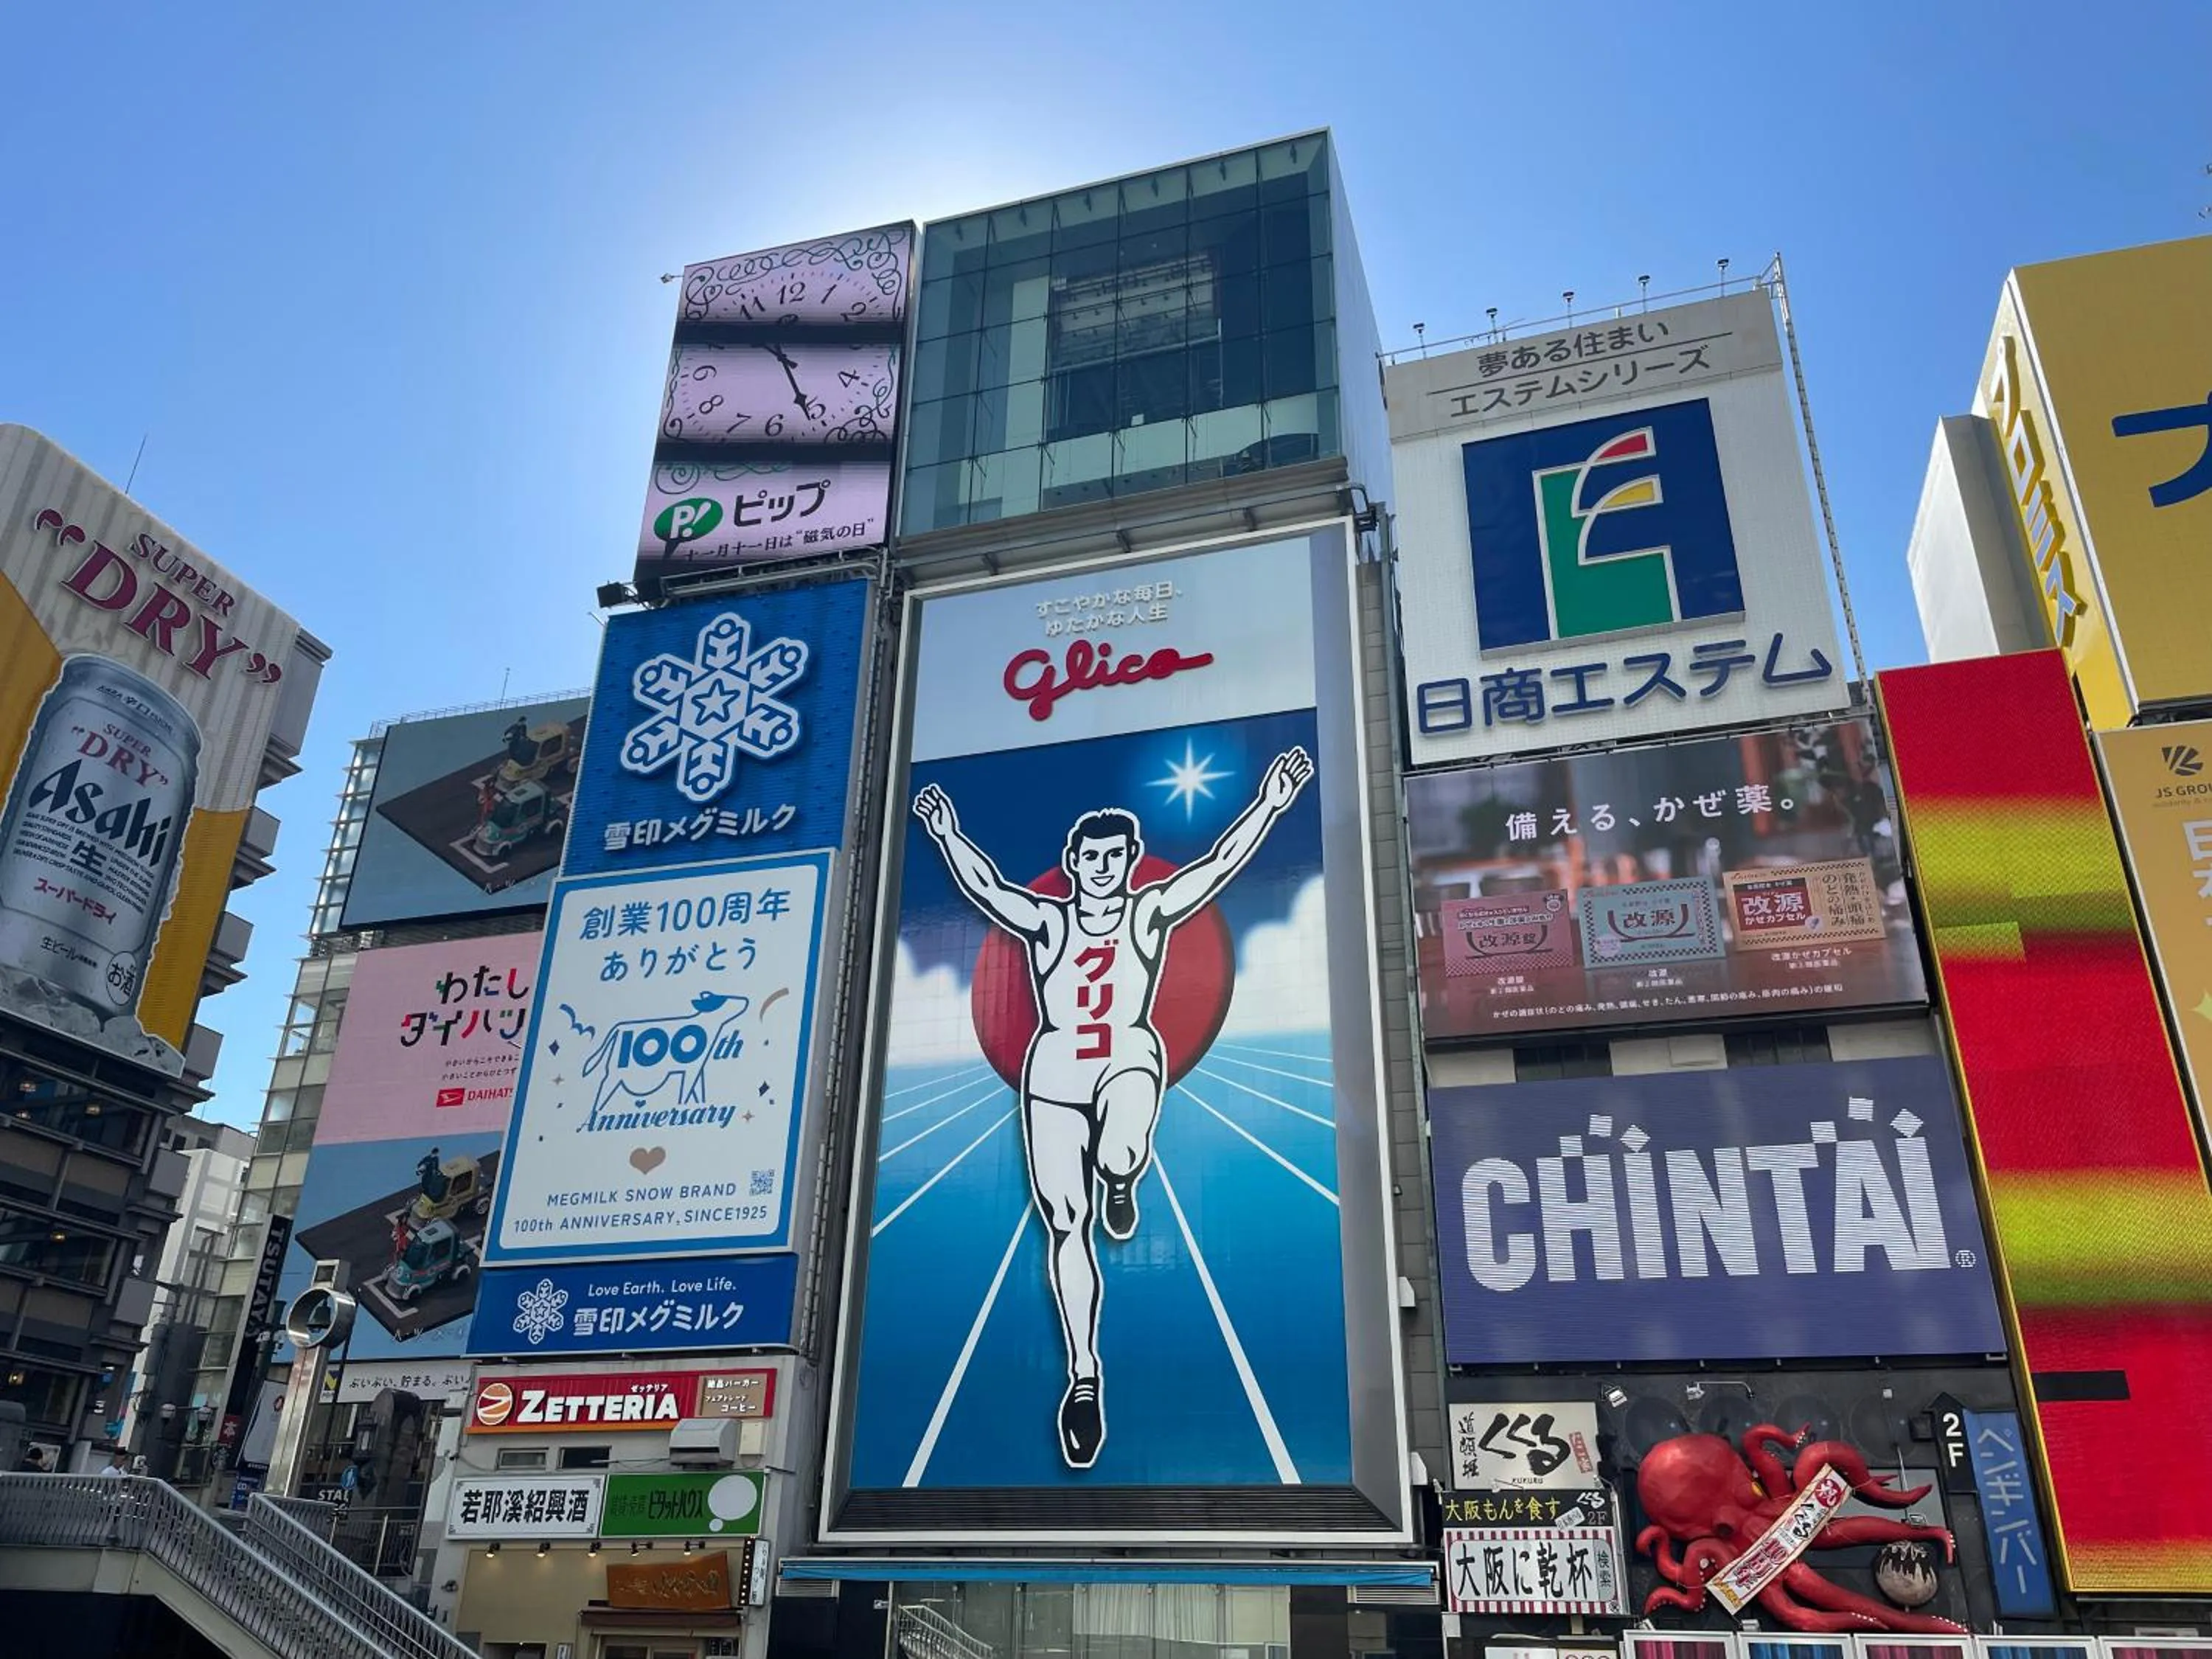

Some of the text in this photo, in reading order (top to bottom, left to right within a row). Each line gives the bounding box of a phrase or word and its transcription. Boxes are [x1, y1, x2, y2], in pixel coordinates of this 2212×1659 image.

[739, 296, 766, 320] 11
[776, 282, 806, 305] 12
[1477, 321, 1669, 378] 夢ある住まい
[1450, 345, 1711, 418] エステムシリーズ
[698, 394, 724, 414] 8
[726, 413, 752, 433] 7
[765, 414, 784, 437] 6
[734, 479, 831, 527] ピップ
[130, 532, 236, 618] SUPER
[1036, 580, 1183, 618] すこやかな毎日、
[1045, 604, 1169, 637] ゆたかな人生
[1416, 633, 1834, 734] 日商エステム
[103, 723, 152, 754] SUPER
[2155, 786, 2172, 799] JS
[29, 759, 172, 868] Asahi
[604, 804, 796, 850] 雪印メグミルク
[1506, 785, 1796, 842] 備える、かぜ薬。
[71, 840, 106, 877] 生
[34, 877, 117, 926] スーパードライ
[580, 887, 792, 940] 創業100周年
[1623, 909, 1675, 928] 改源
[1742, 891, 1805, 915] 改源
[1745, 913, 1806, 925] かぜカプセル
[600, 937, 757, 982] ありがとう
[437, 965, 529, 1004] わたし
[1074, 939, 1119, 1060] グリコ
[400, 1008, 526, 1048] ダイハツ
[616, 1024, 744, 1068] 100th
[577, 1103, 737, 1133] Anniversary
[547, 1182, 737, 1207] MEGMILK SNOW BRAND
[515, 1219, 553, 1233] 100th
[588, 1277, 737, 1297] Love Earth. Love Life.
[573, 1299, 745, 1337] 雪印メグミルク
[631, 1383, 669, 1393] ゼッテリア
[517, 1389, 680, 1424] ZETTERIA
[720, 1403, 757, 1413] コーヒー
[1478, 1413, 1571, 1476] くくる
[1943, 1411, 1964, 1467] 2F
[460, 1488, 590, 1524] 若耶溪紹興酒
[1445, 1496, 1561, 1522] 大阪もんを食す
[1576, 1492, 1605, 1509] くくる
[1587, 1512, 1607, 1525] 2F
[1977, 1427, 2037, 1594] ペンギンバー
[1456, 1543, 1593, 1599] 大阪に乾杯
